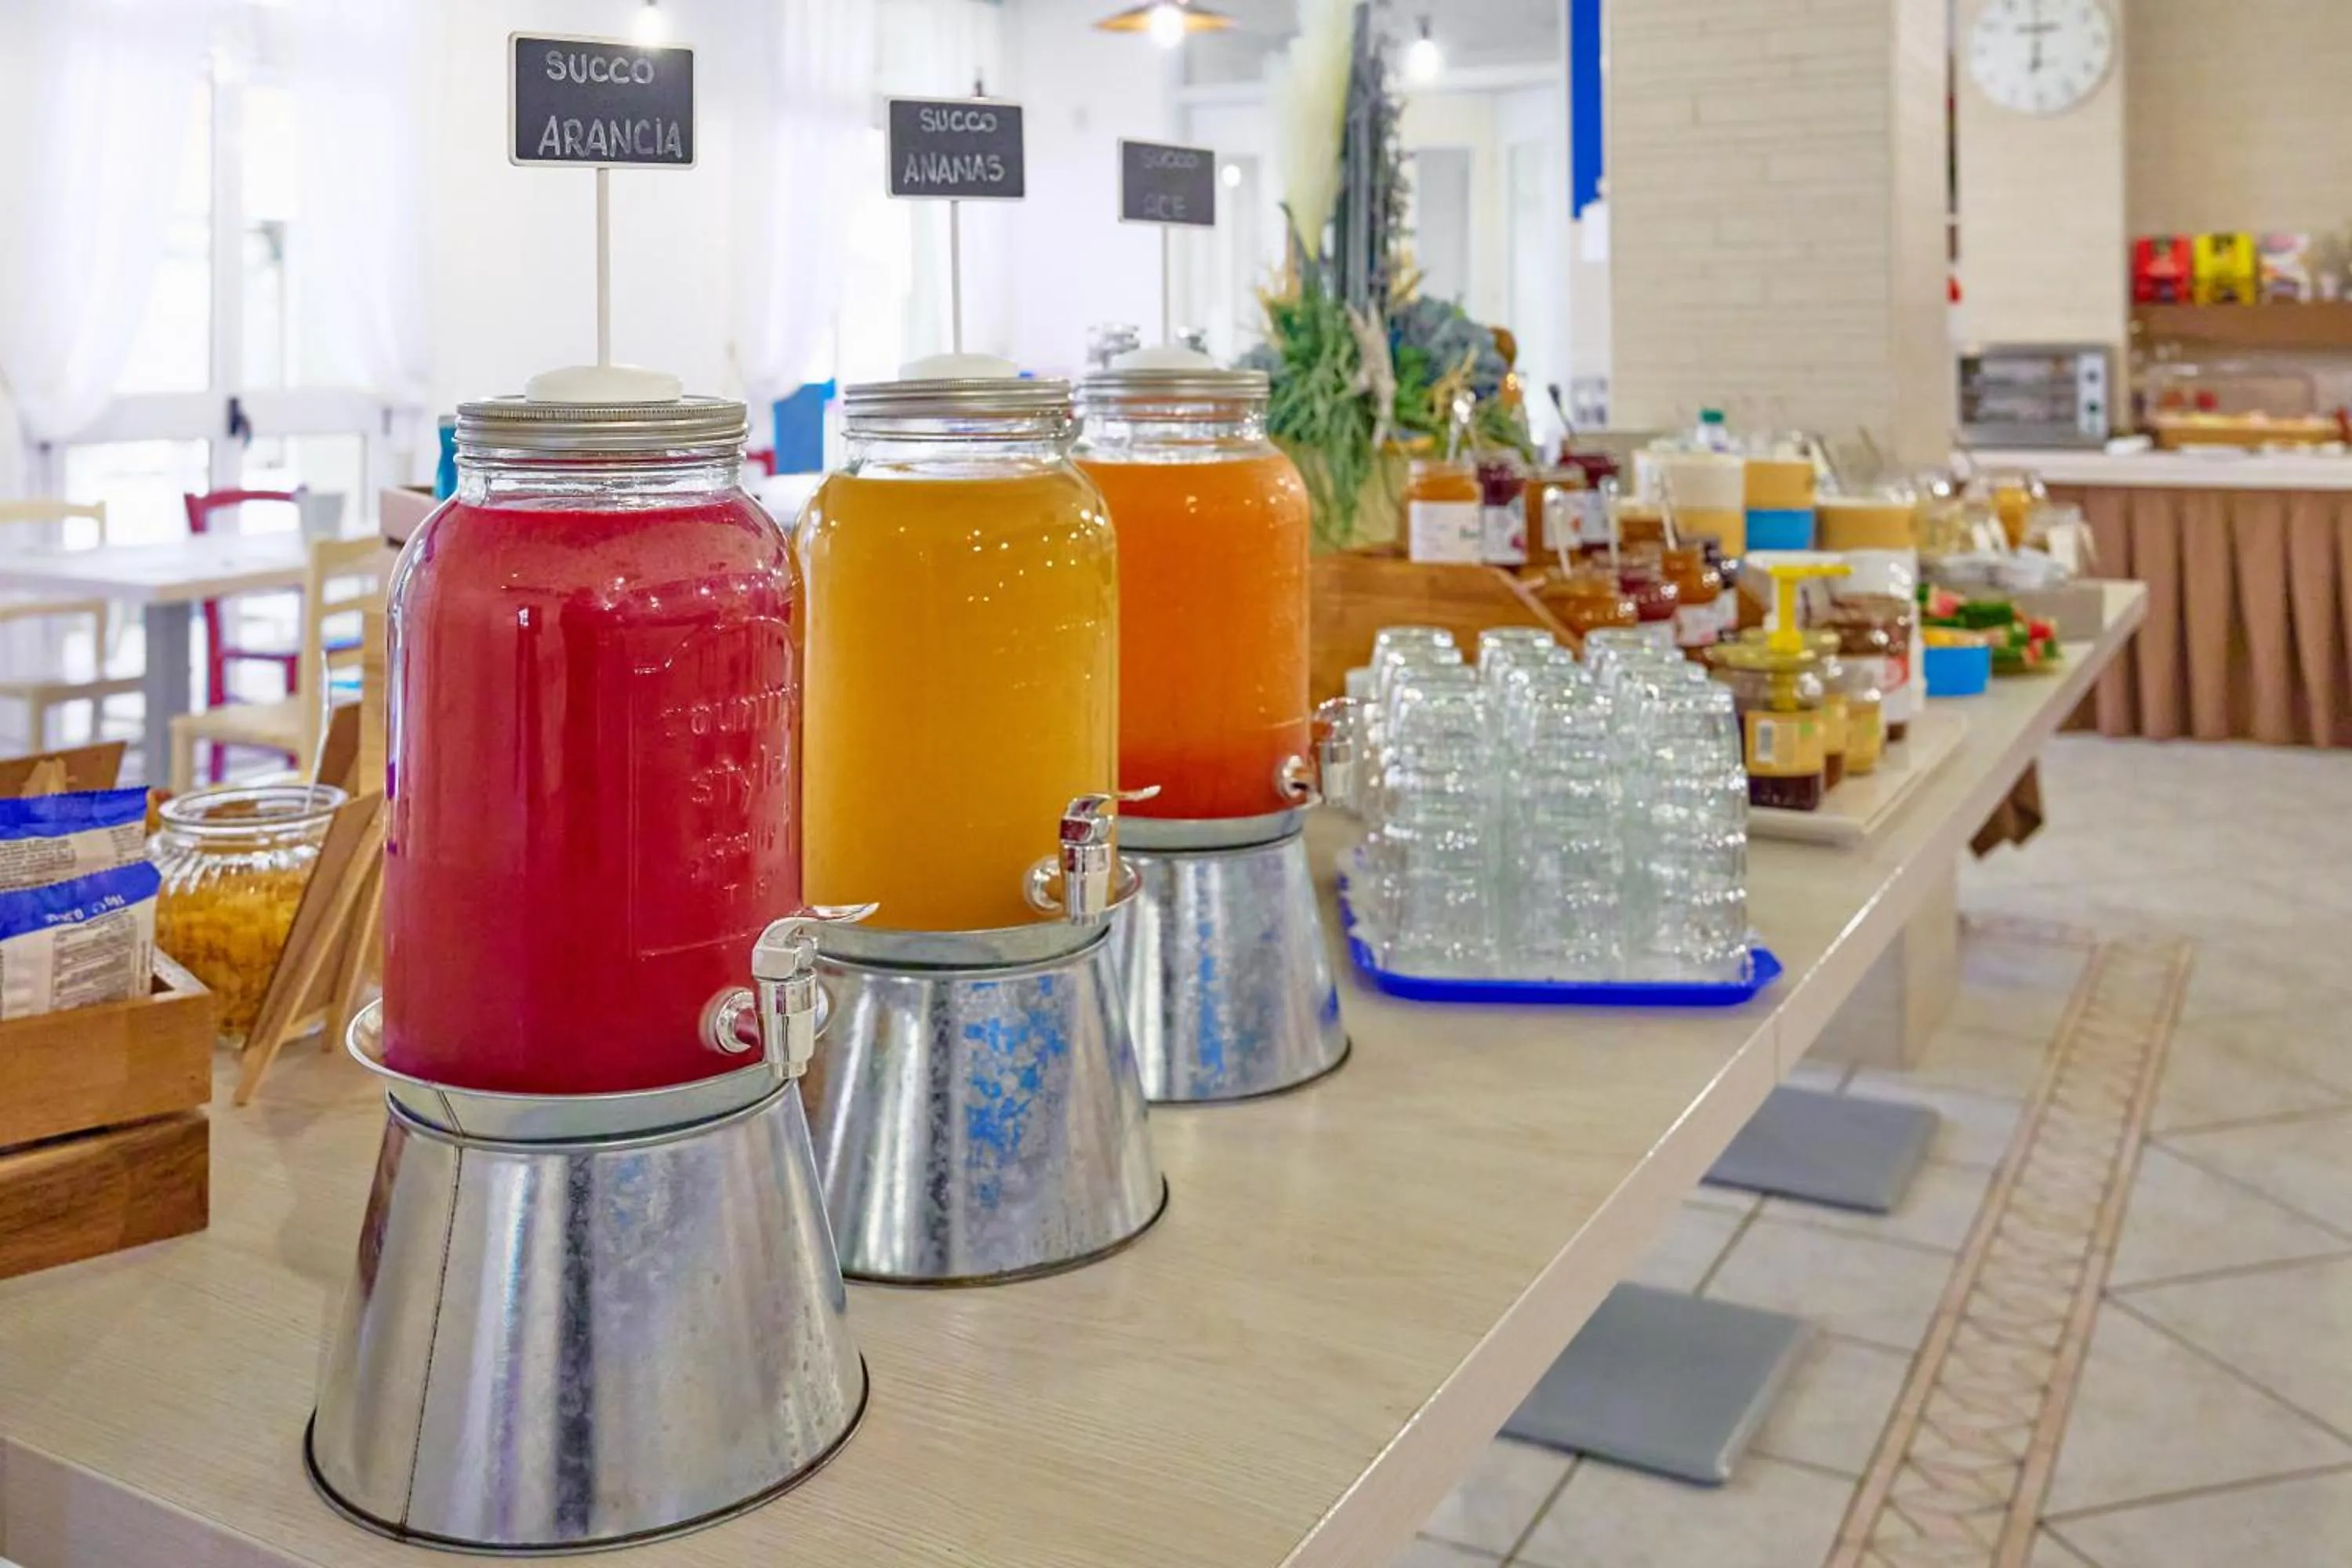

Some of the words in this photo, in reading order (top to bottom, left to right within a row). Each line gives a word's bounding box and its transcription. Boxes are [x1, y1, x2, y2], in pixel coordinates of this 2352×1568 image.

[545, 50, 655, 84] SUCCO
[919, 107, 997, 132] SUCCO
[903, 152, 1006, 185] ANANAS
